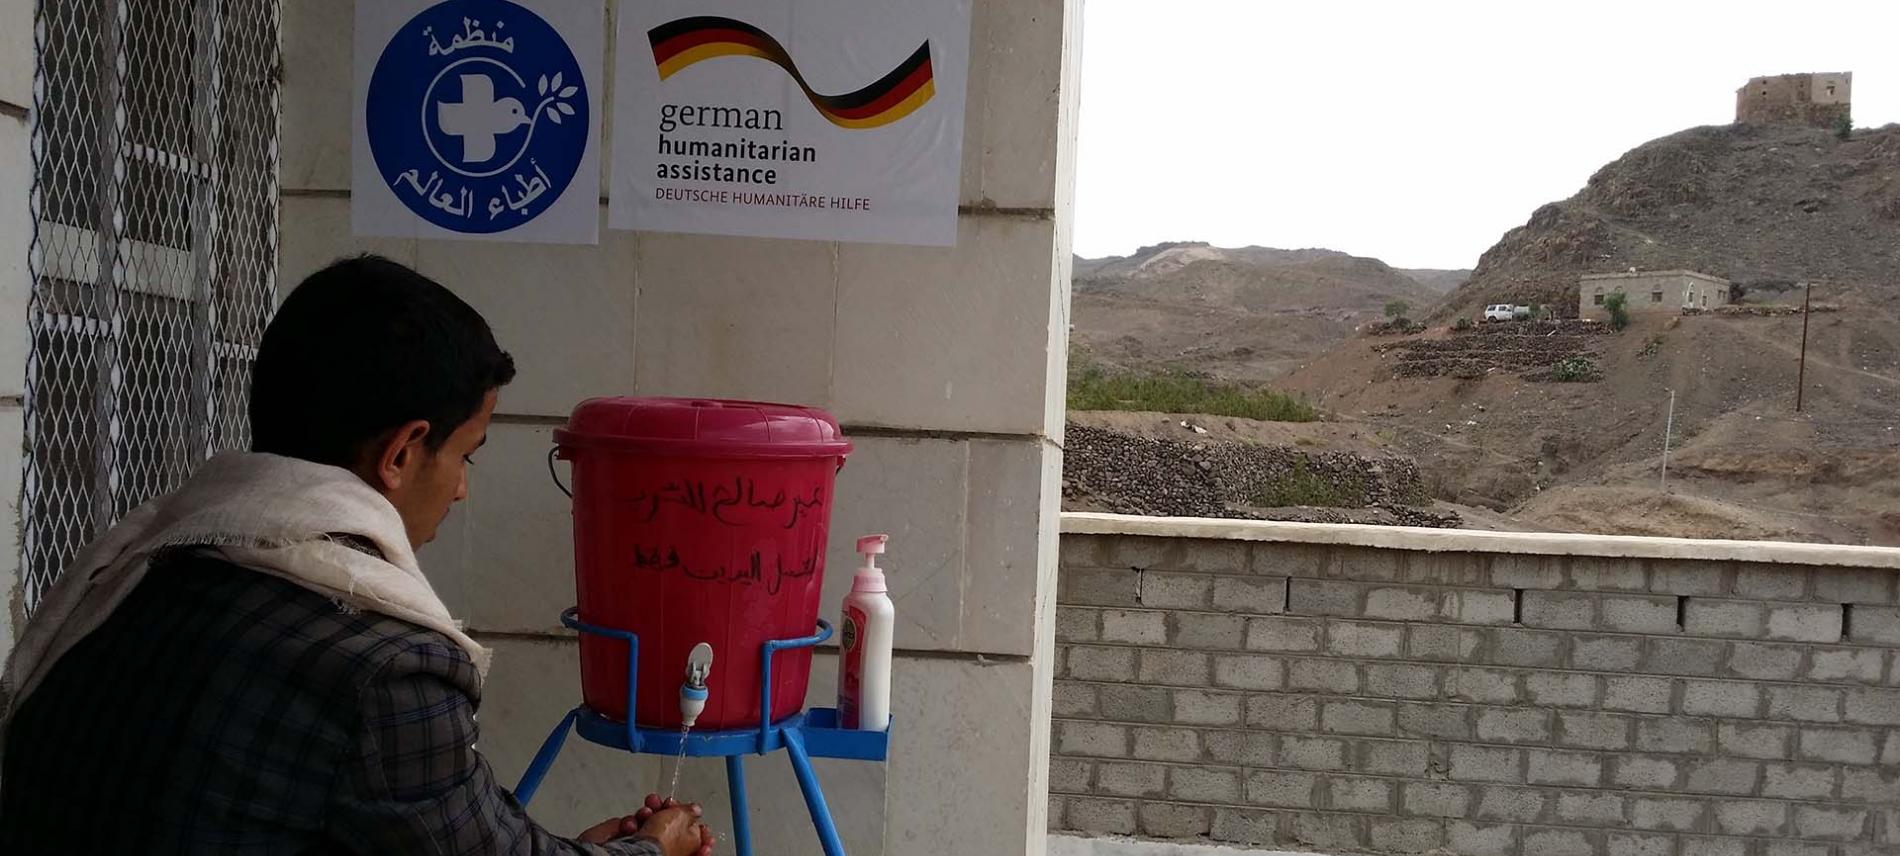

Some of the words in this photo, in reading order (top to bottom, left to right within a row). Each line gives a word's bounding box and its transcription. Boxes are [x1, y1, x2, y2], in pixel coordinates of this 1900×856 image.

[423, 16, 515, 56] منظمة
[659, 103, 783, 132] german
[658, 134, 816, 163] humanitarian
[487, 158, 551, 220] أطباء
[656, 160, 777, 185] assistance
[393, 168, 474, 219] العالم
[655, 187, 728, 204] DEUTSCHE
[732, 190, 826, 209] HUMANITÄRE
[830, 196, 871, 211] HILFE
[712, 476, 785, 526] صالح
[783, 484, 824, 529] غير
